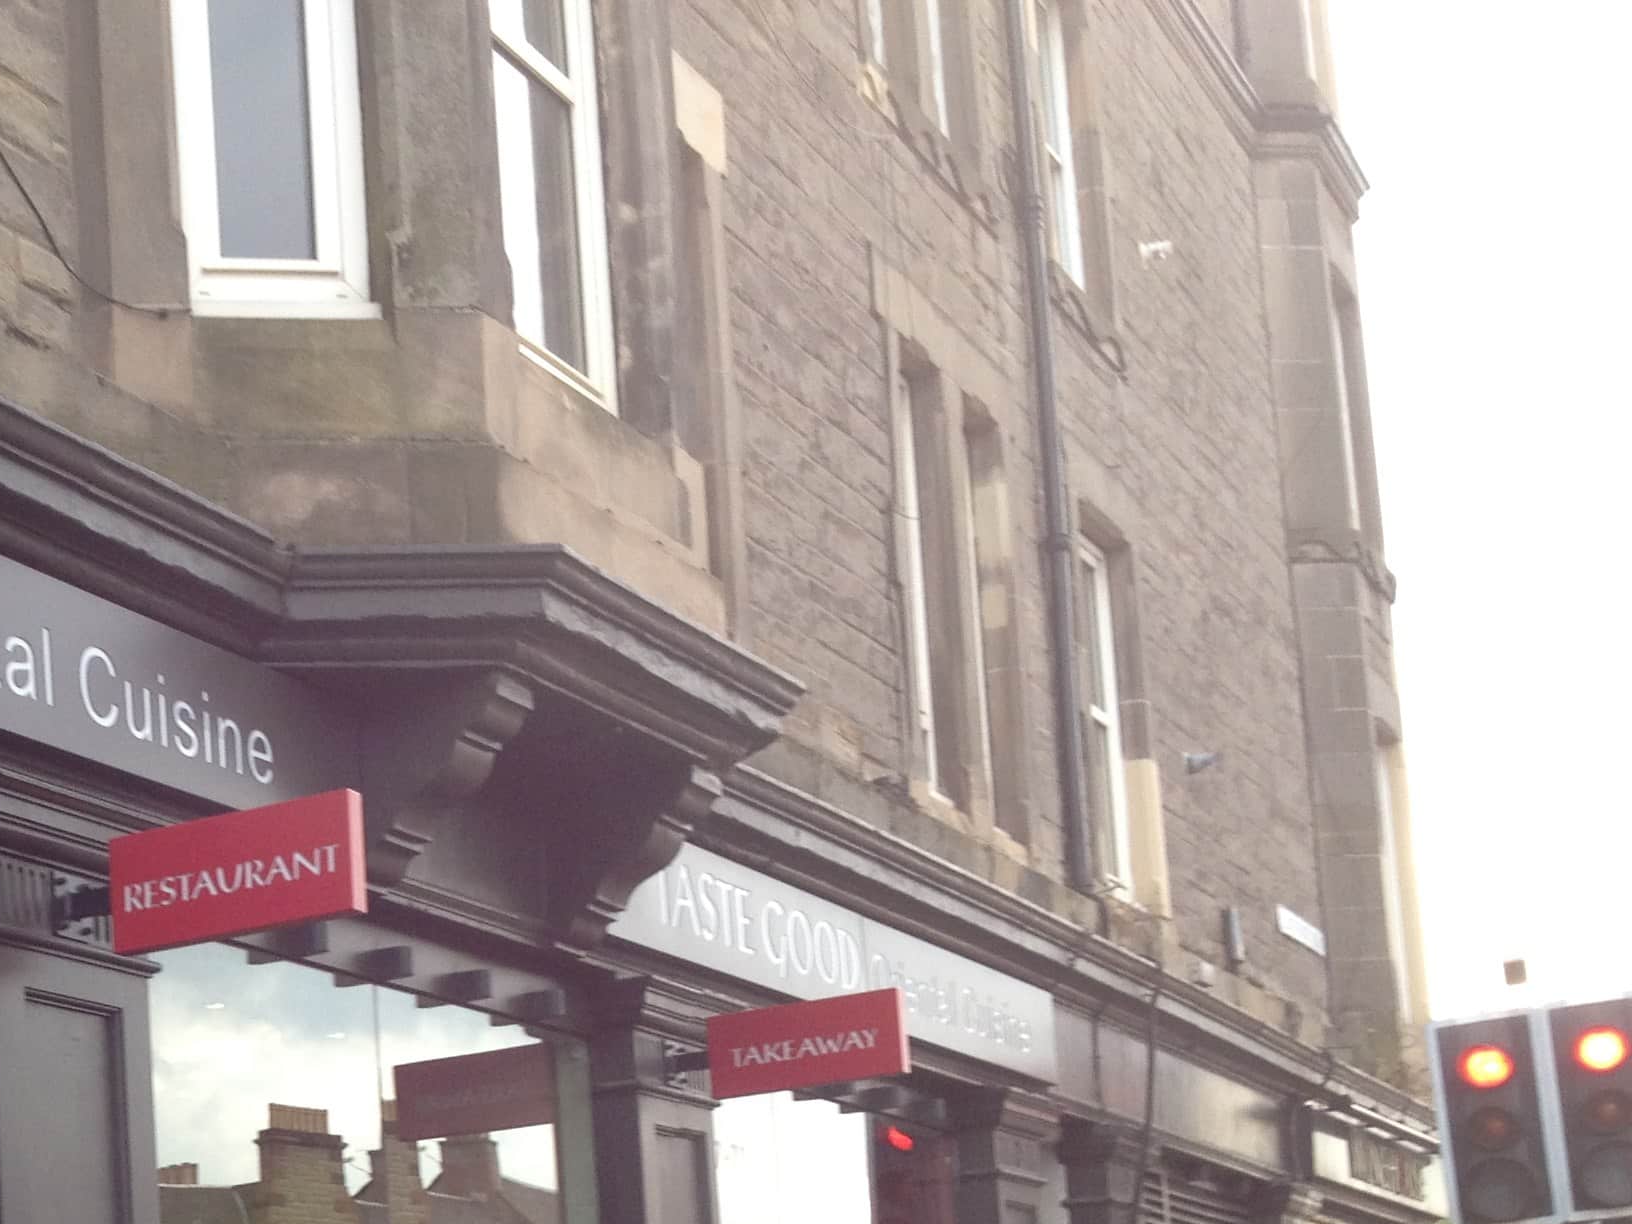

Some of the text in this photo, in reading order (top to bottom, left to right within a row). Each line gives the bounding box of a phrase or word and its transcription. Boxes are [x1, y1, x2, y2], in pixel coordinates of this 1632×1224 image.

[78, 646, 275, 785] Cuisine
[122, 843, 341, 914] RESTAURANT
[658, 863, 756, 955] TASTE
[760, 900, 862, 990] GOOD
[729, 1027, 880, 1068] TAKEAWAY
